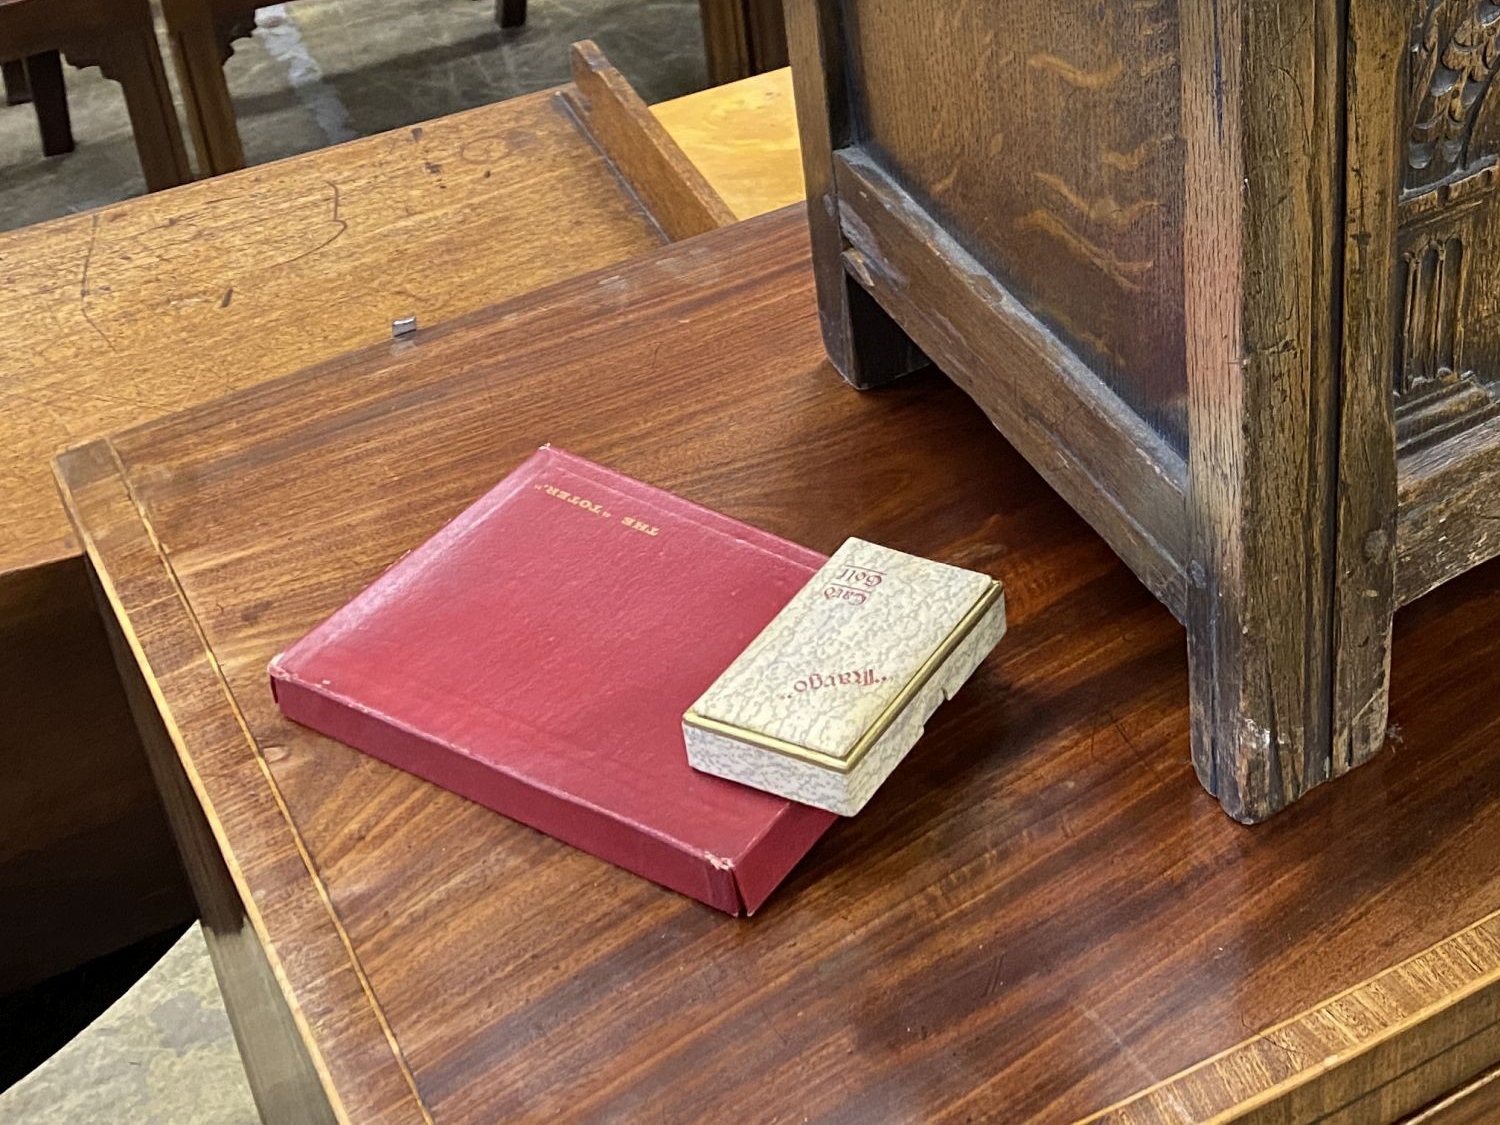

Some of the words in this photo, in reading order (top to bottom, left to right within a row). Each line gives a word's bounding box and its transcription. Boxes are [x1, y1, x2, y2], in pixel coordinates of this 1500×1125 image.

[621, 516, 660, 536] THE
[836, 568, 882, 588] Golf
[823, 586, 867, 606] Card
